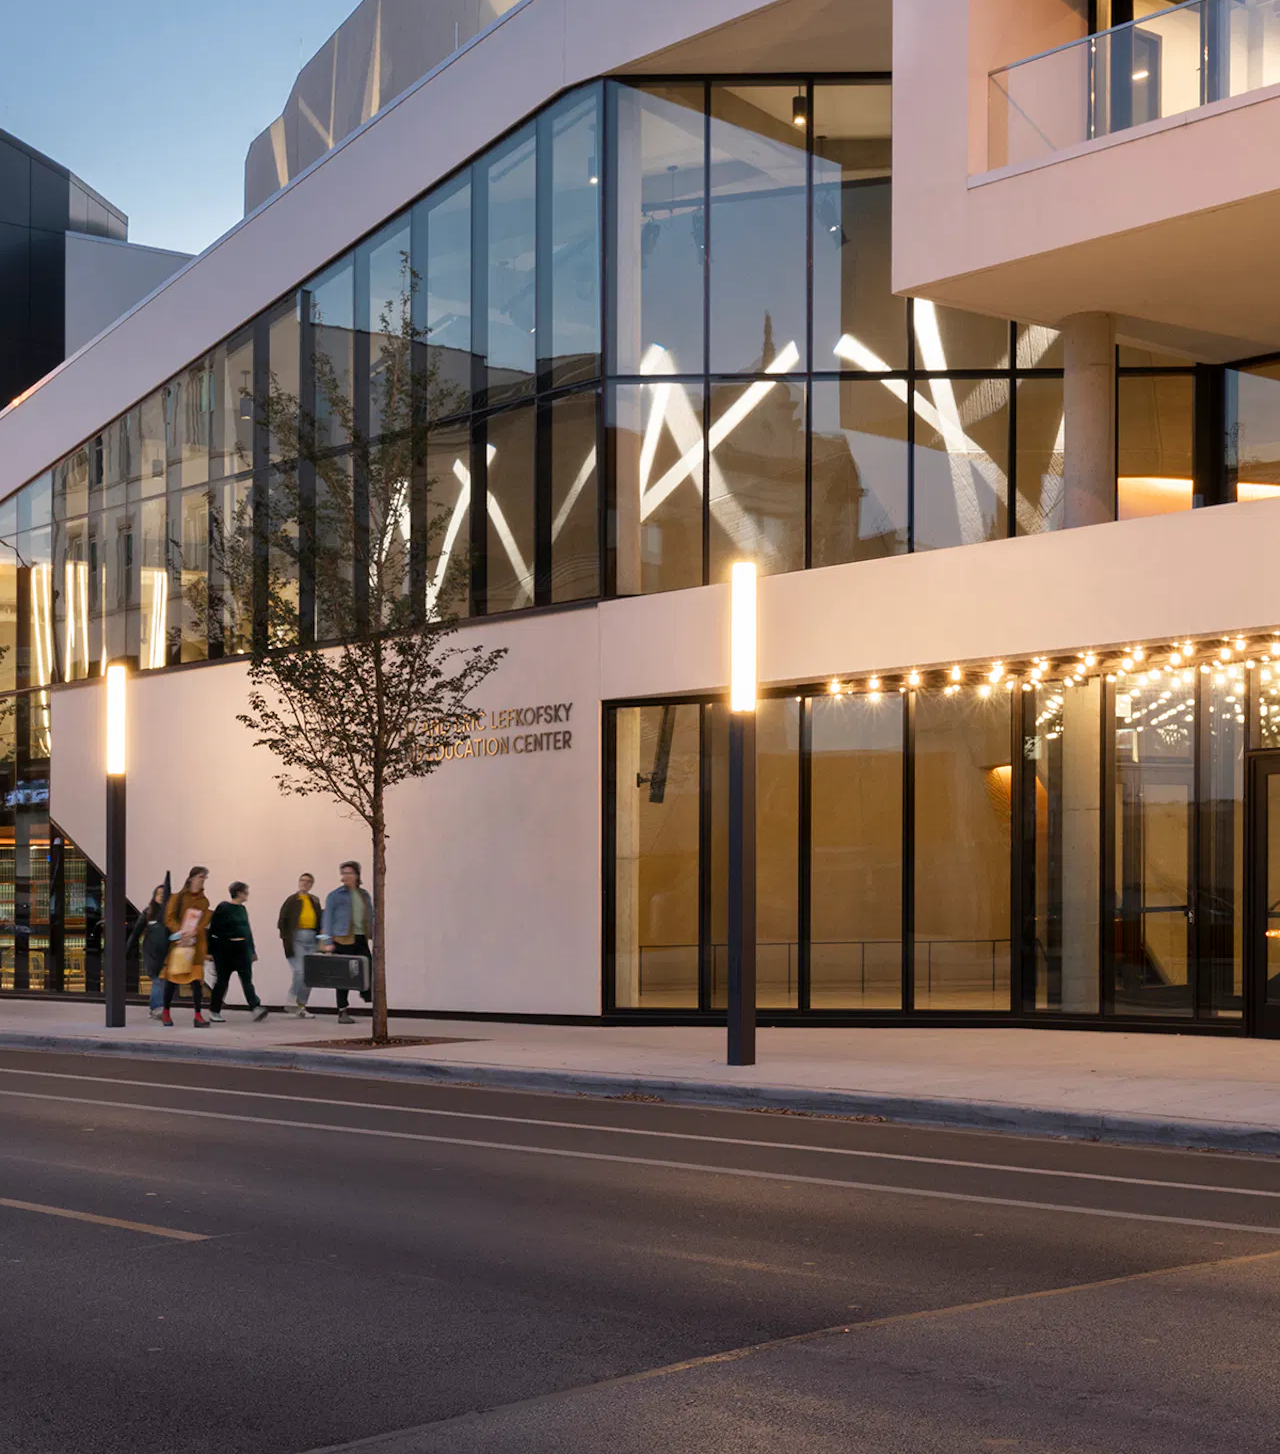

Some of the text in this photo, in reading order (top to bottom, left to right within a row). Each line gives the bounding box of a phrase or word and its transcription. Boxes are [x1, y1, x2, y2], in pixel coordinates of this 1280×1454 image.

[490, 702, 573, 730] LEFKOFSKY
[425, 736, 509, 762] EDUCATION
[513, 731, 572, 754] CENTER
